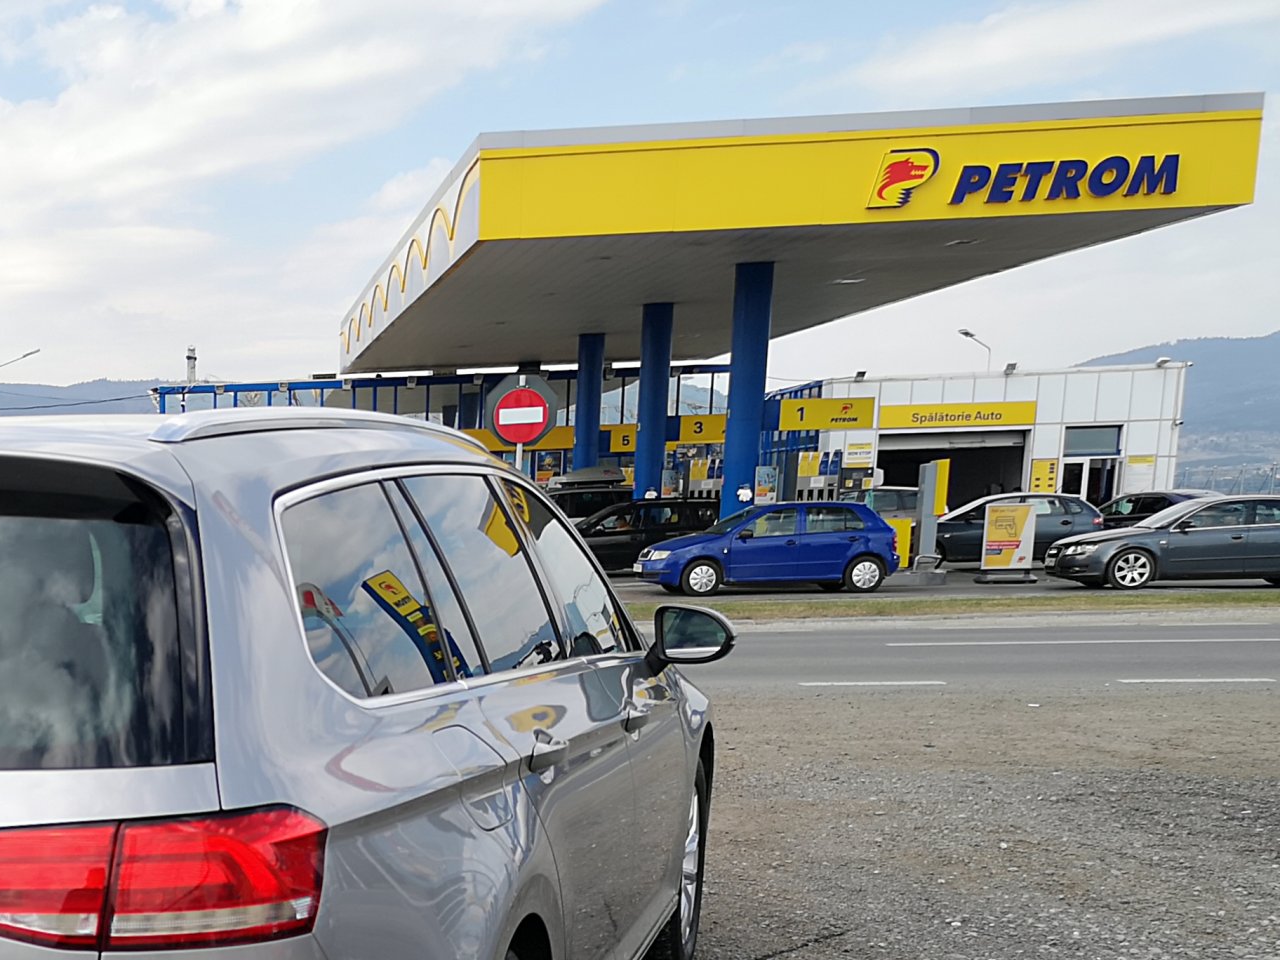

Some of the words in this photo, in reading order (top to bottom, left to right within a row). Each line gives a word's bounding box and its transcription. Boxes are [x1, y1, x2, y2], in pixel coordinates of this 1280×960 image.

[947, 153, 1181, 206] PETROM
[796, 406, 805, 422] 1
[829, 416, 859, 424] PETROM
[911, 411, 972, 424] Spălătorie
[974, 410, 1003, 422] Auto
[693, 421, 704, 435] 3
[621, 434, 630, 446] 5
